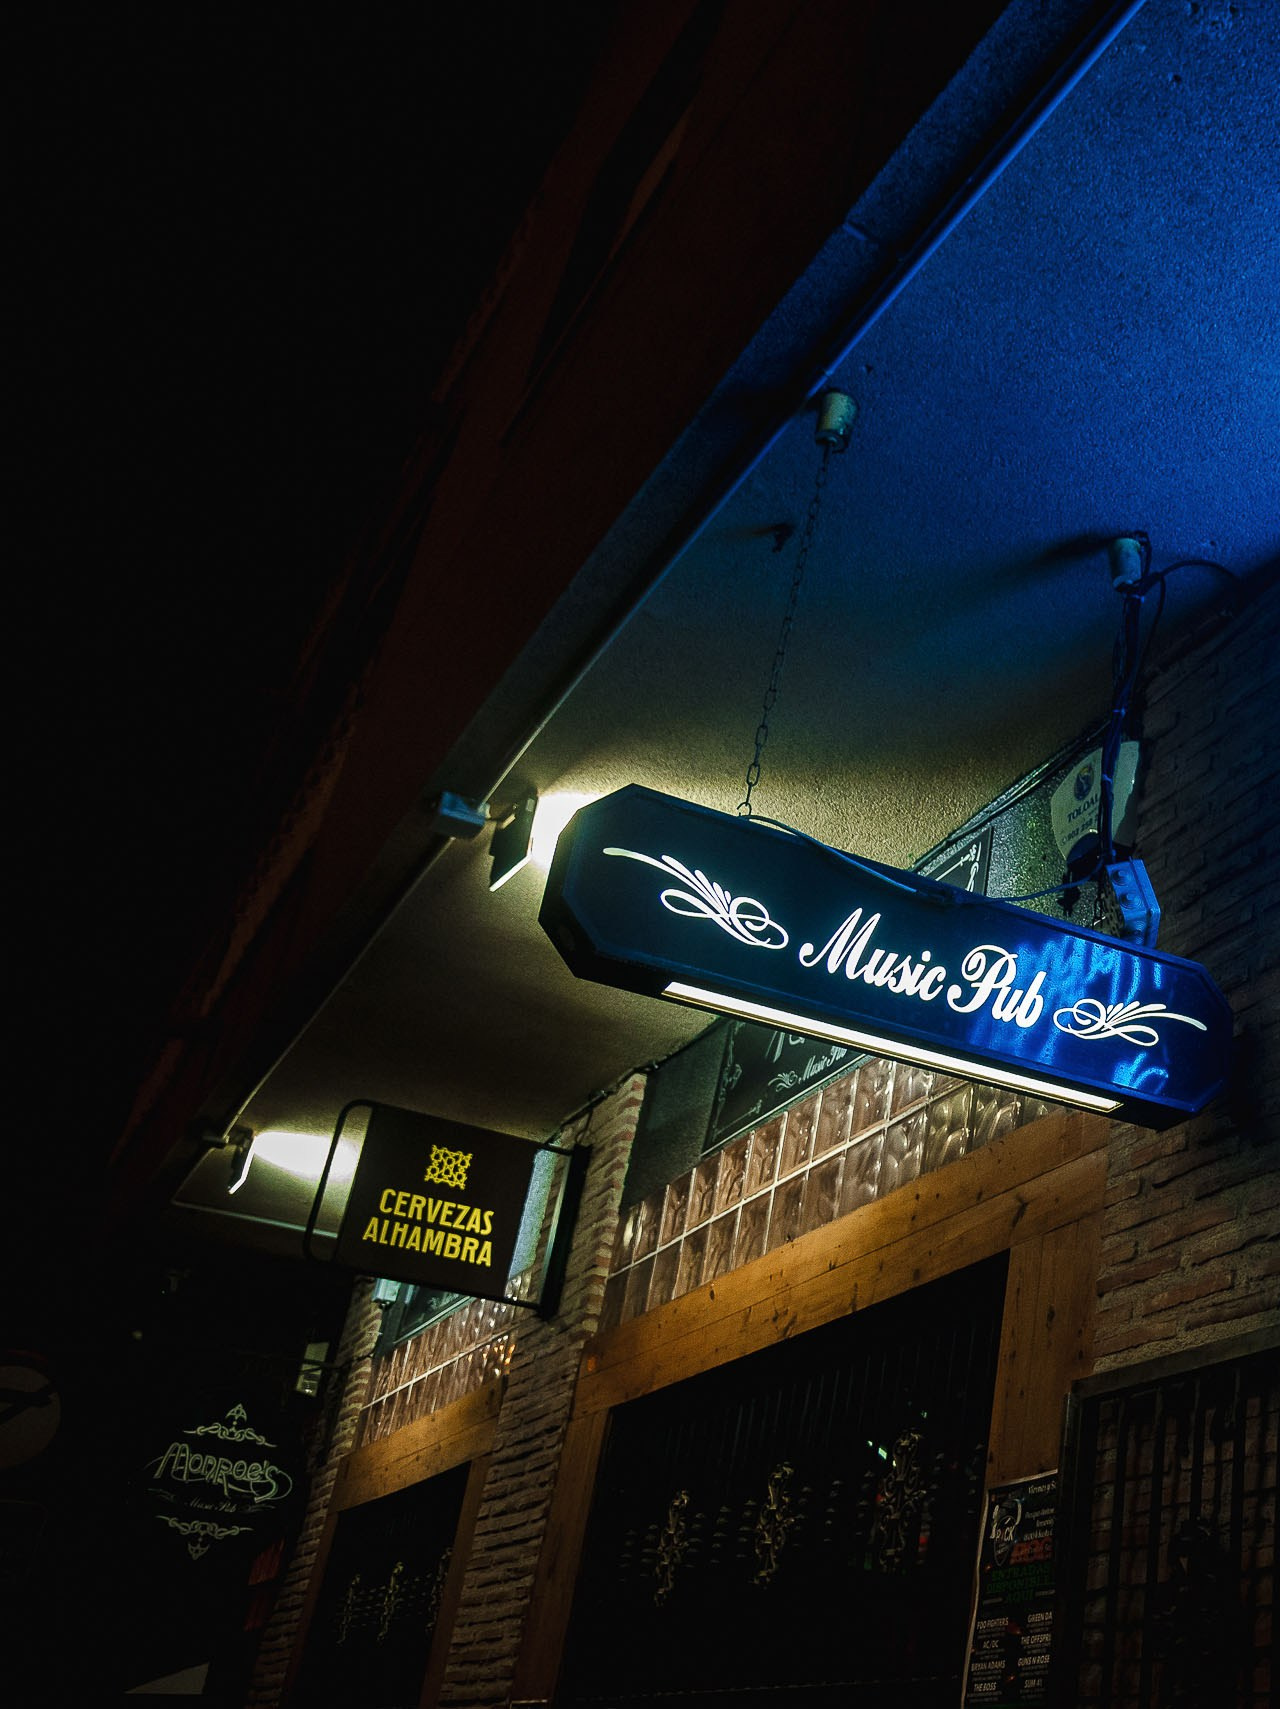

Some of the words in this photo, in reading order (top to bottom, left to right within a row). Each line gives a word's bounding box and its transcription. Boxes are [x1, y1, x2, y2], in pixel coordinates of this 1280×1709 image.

[799, 907, 947, 1002] Music
[947, 944, 1045, 1029] Pub
[379, 1188, 495, 1237] CERVEZAS
[362, 1216, 494, 1268] ALHAMBRA
